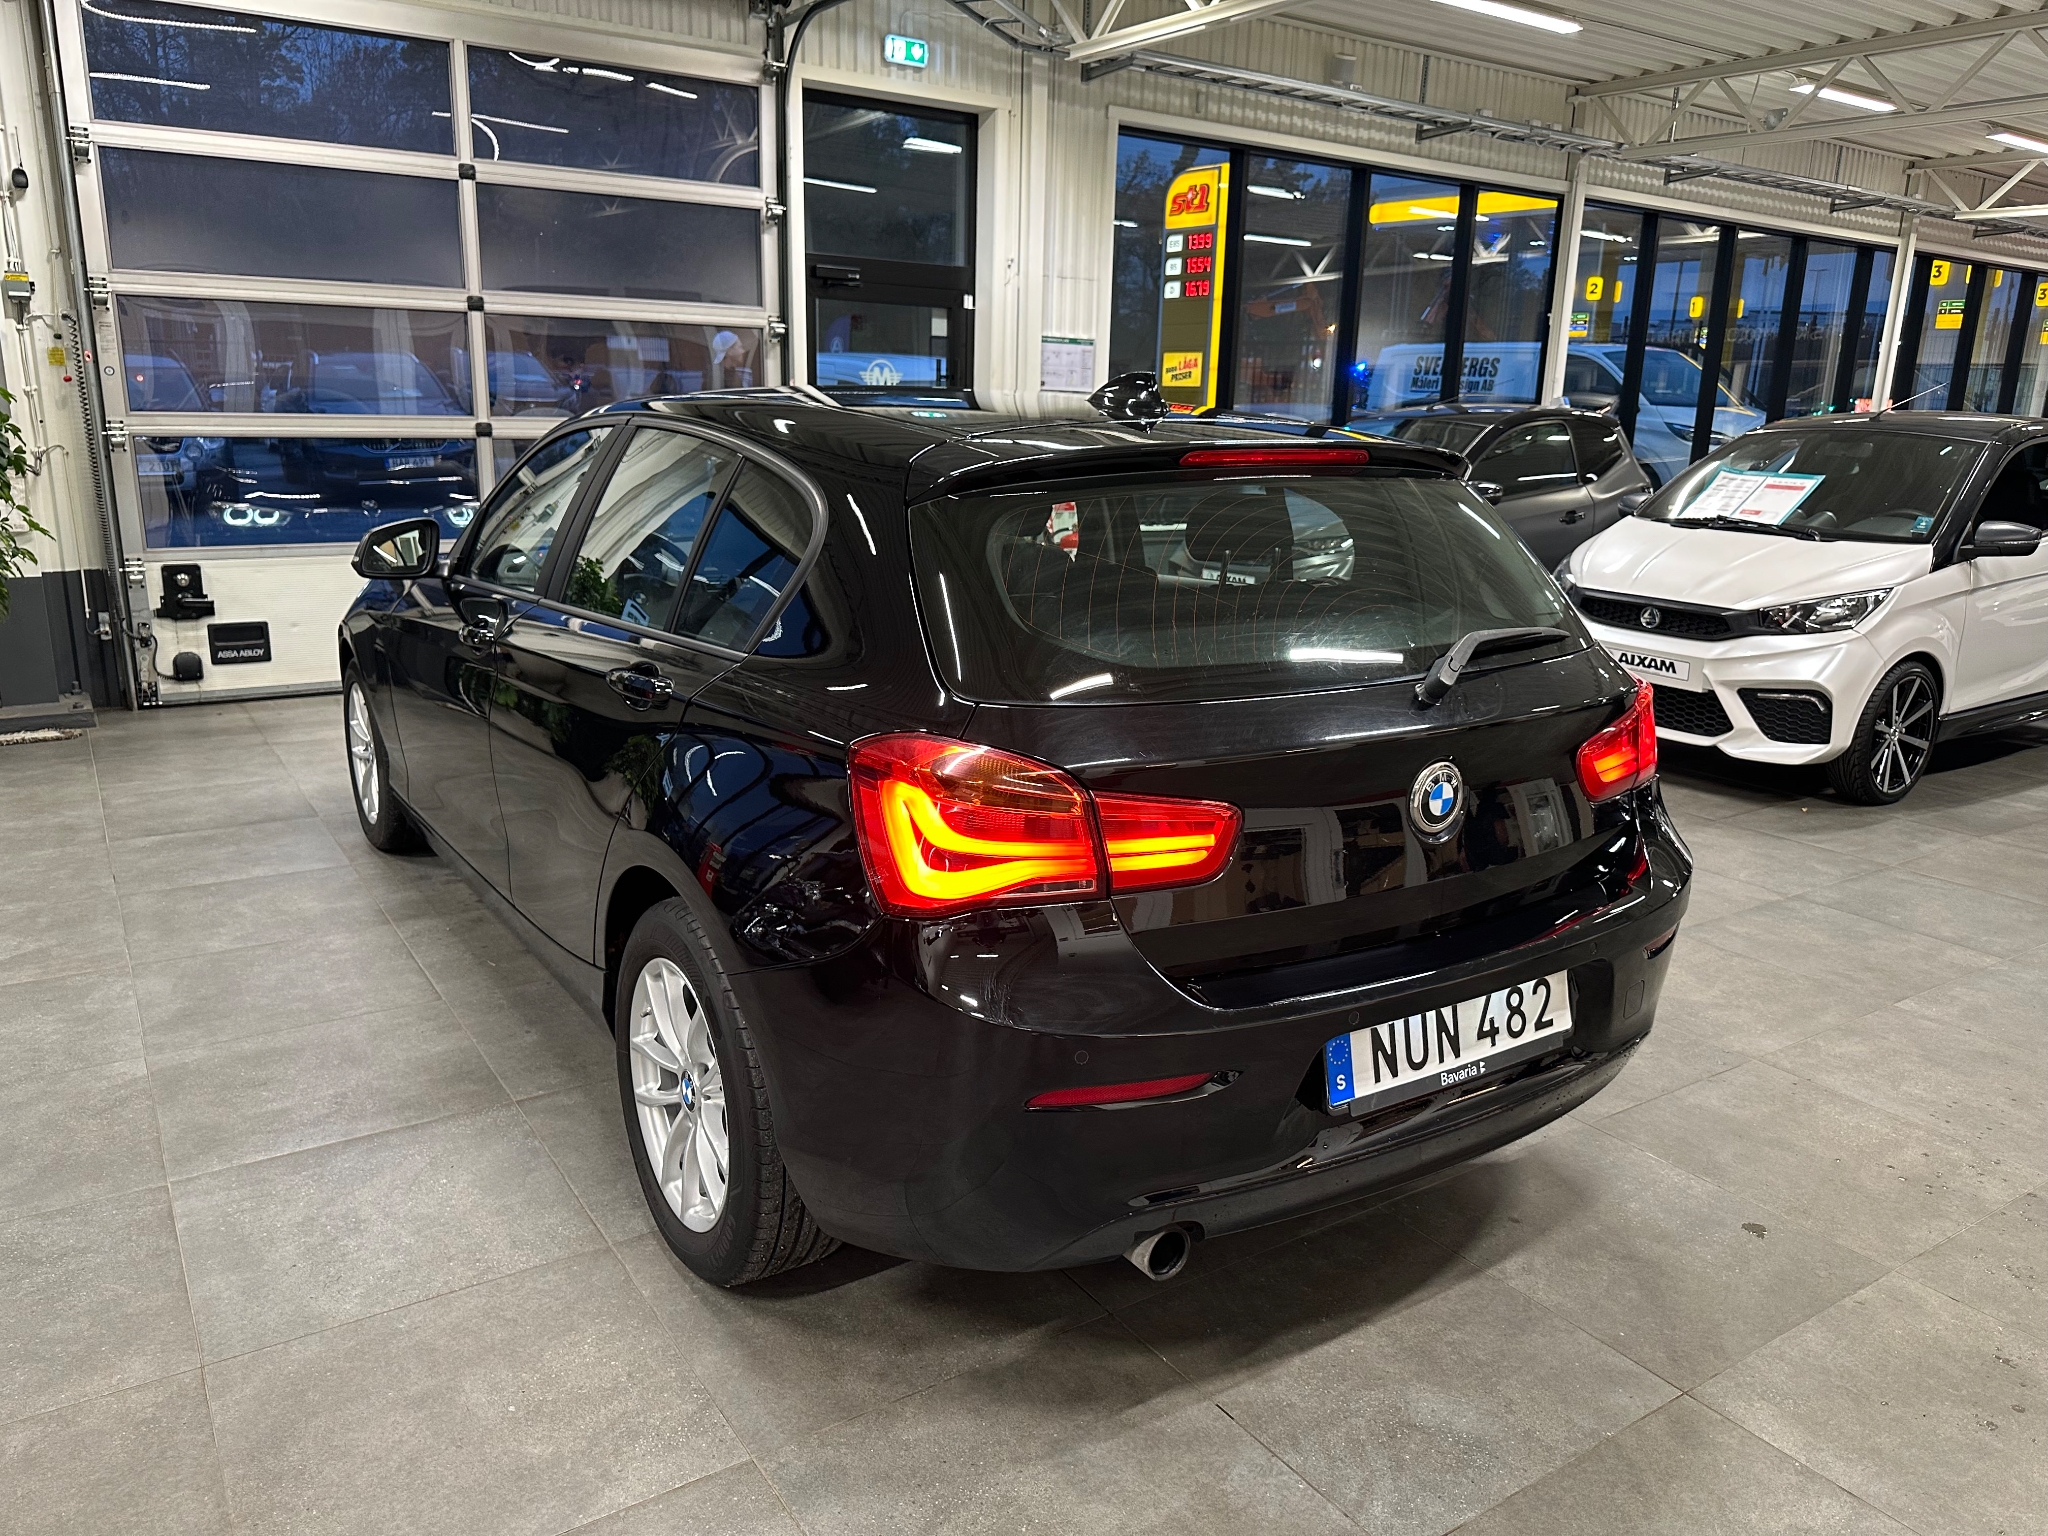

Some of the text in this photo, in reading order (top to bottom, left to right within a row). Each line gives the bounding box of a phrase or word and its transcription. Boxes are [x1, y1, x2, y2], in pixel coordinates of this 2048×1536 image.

[1932, 264, 1943, 279] 3
[1589, 283, 1598, 295] 2
[2037, 288, 2048, 301] 3
[1481, 379, 1495, 392] AB
[217, 648, 265, 659] ASSA ABLOY
[1618, 652, 1677, 674] AIXAM
[1426, 772, 1458, 793] BMW
[1370, 977, 1554, 1084] NUN 482
[1336, 1074, 1346, 1091] S
[1440, 1063, 1478, 1086] Bavaria
